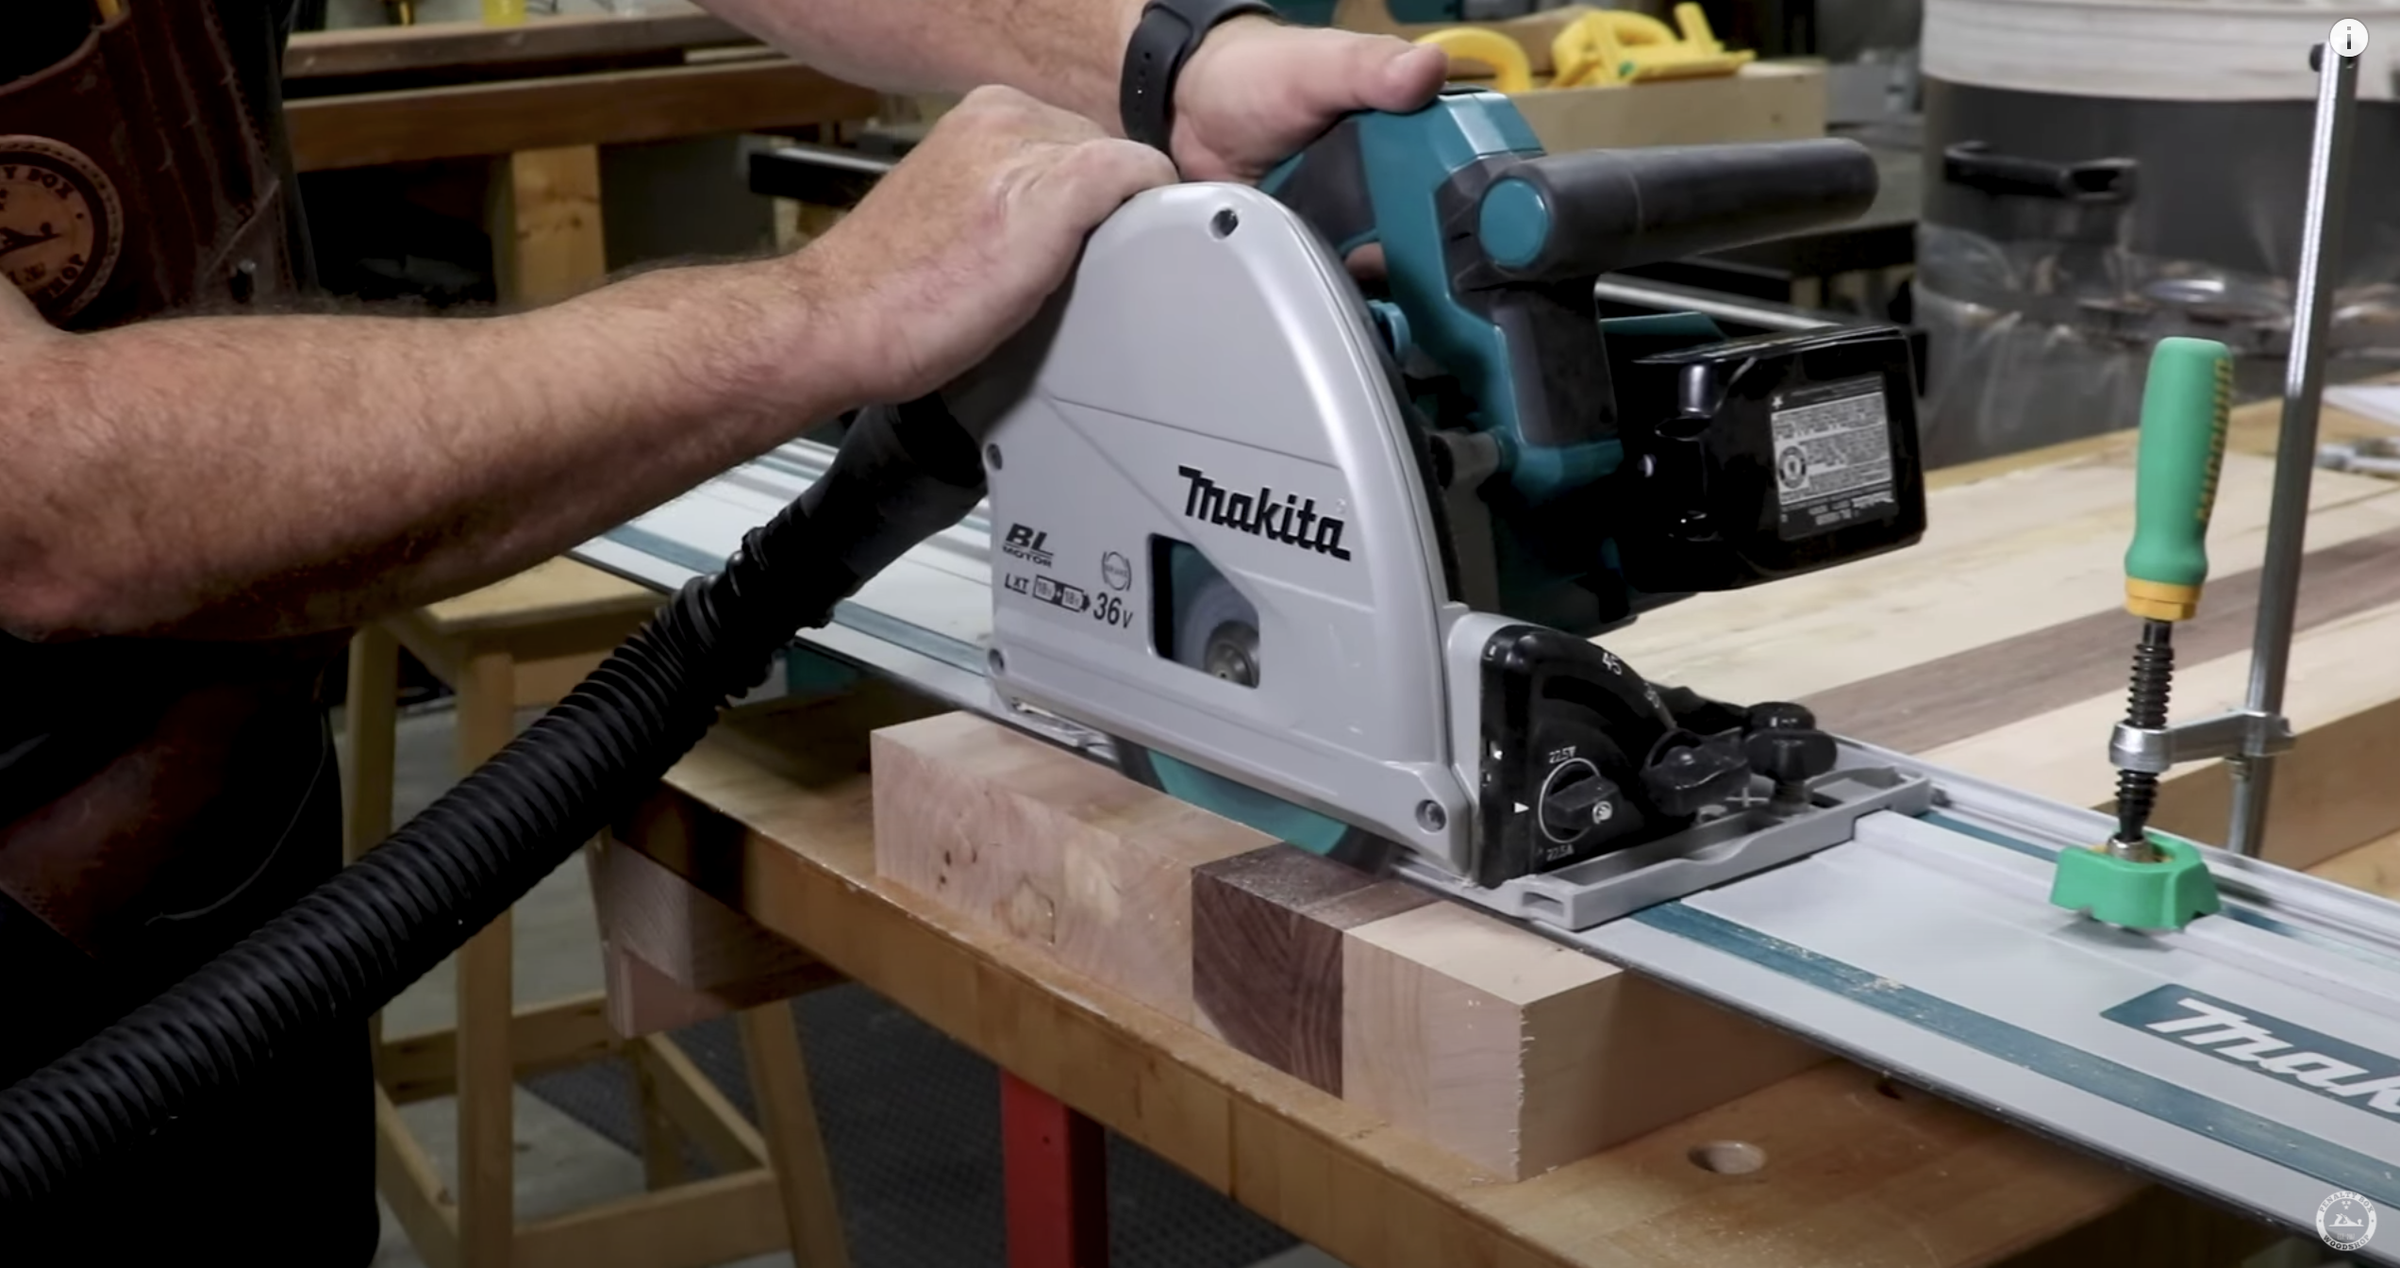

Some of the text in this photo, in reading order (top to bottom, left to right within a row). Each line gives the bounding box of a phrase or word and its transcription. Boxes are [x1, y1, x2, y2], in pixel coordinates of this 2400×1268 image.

[1178, 464, 1351, 562] Makita
[1005, 522, 1054, 557] BL
[1002, 545, 1053, 569] MOTOR
[1004, 573, 1030, 595] LXT
[1602, 652, 1622, 675] 45
